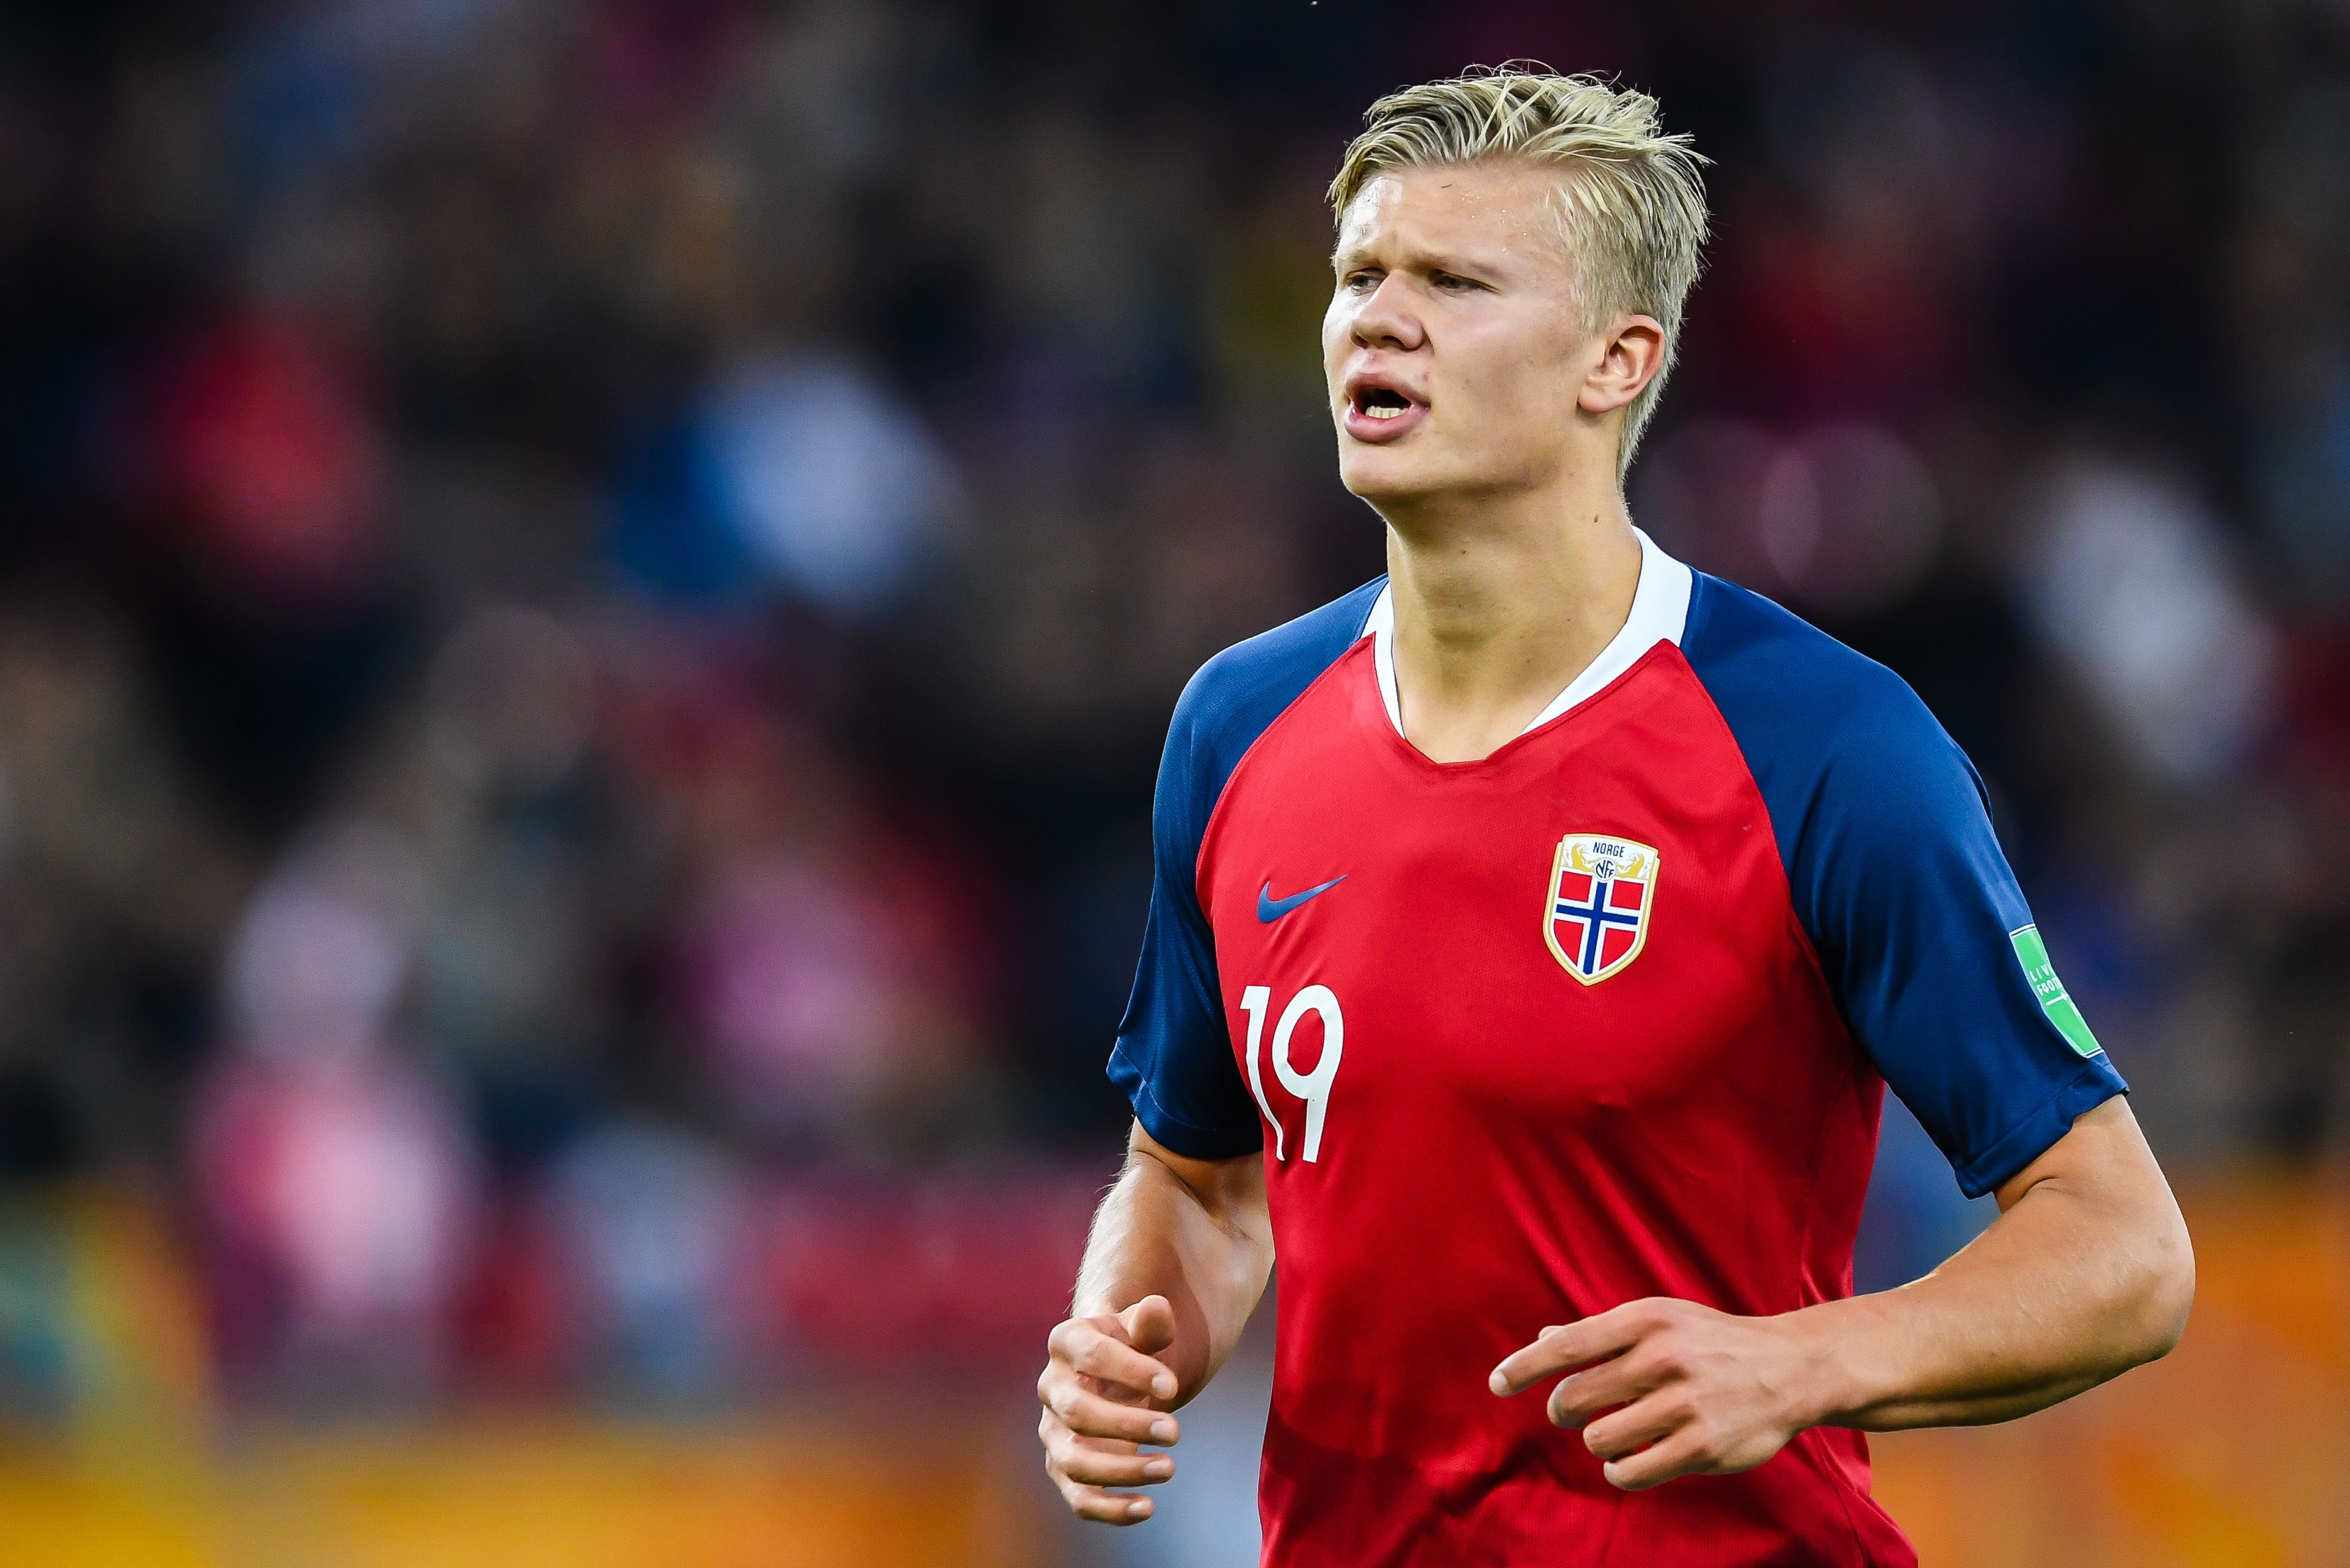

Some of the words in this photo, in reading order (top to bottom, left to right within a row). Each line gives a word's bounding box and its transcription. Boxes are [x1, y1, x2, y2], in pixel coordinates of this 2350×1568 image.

[1593, 842, 1626, 858] NORGE
[2029, 964, 2051, 983] LIV
[2035, 977, 2063, 996] FOOT
[1239, 984, 1344, 1163] 19
